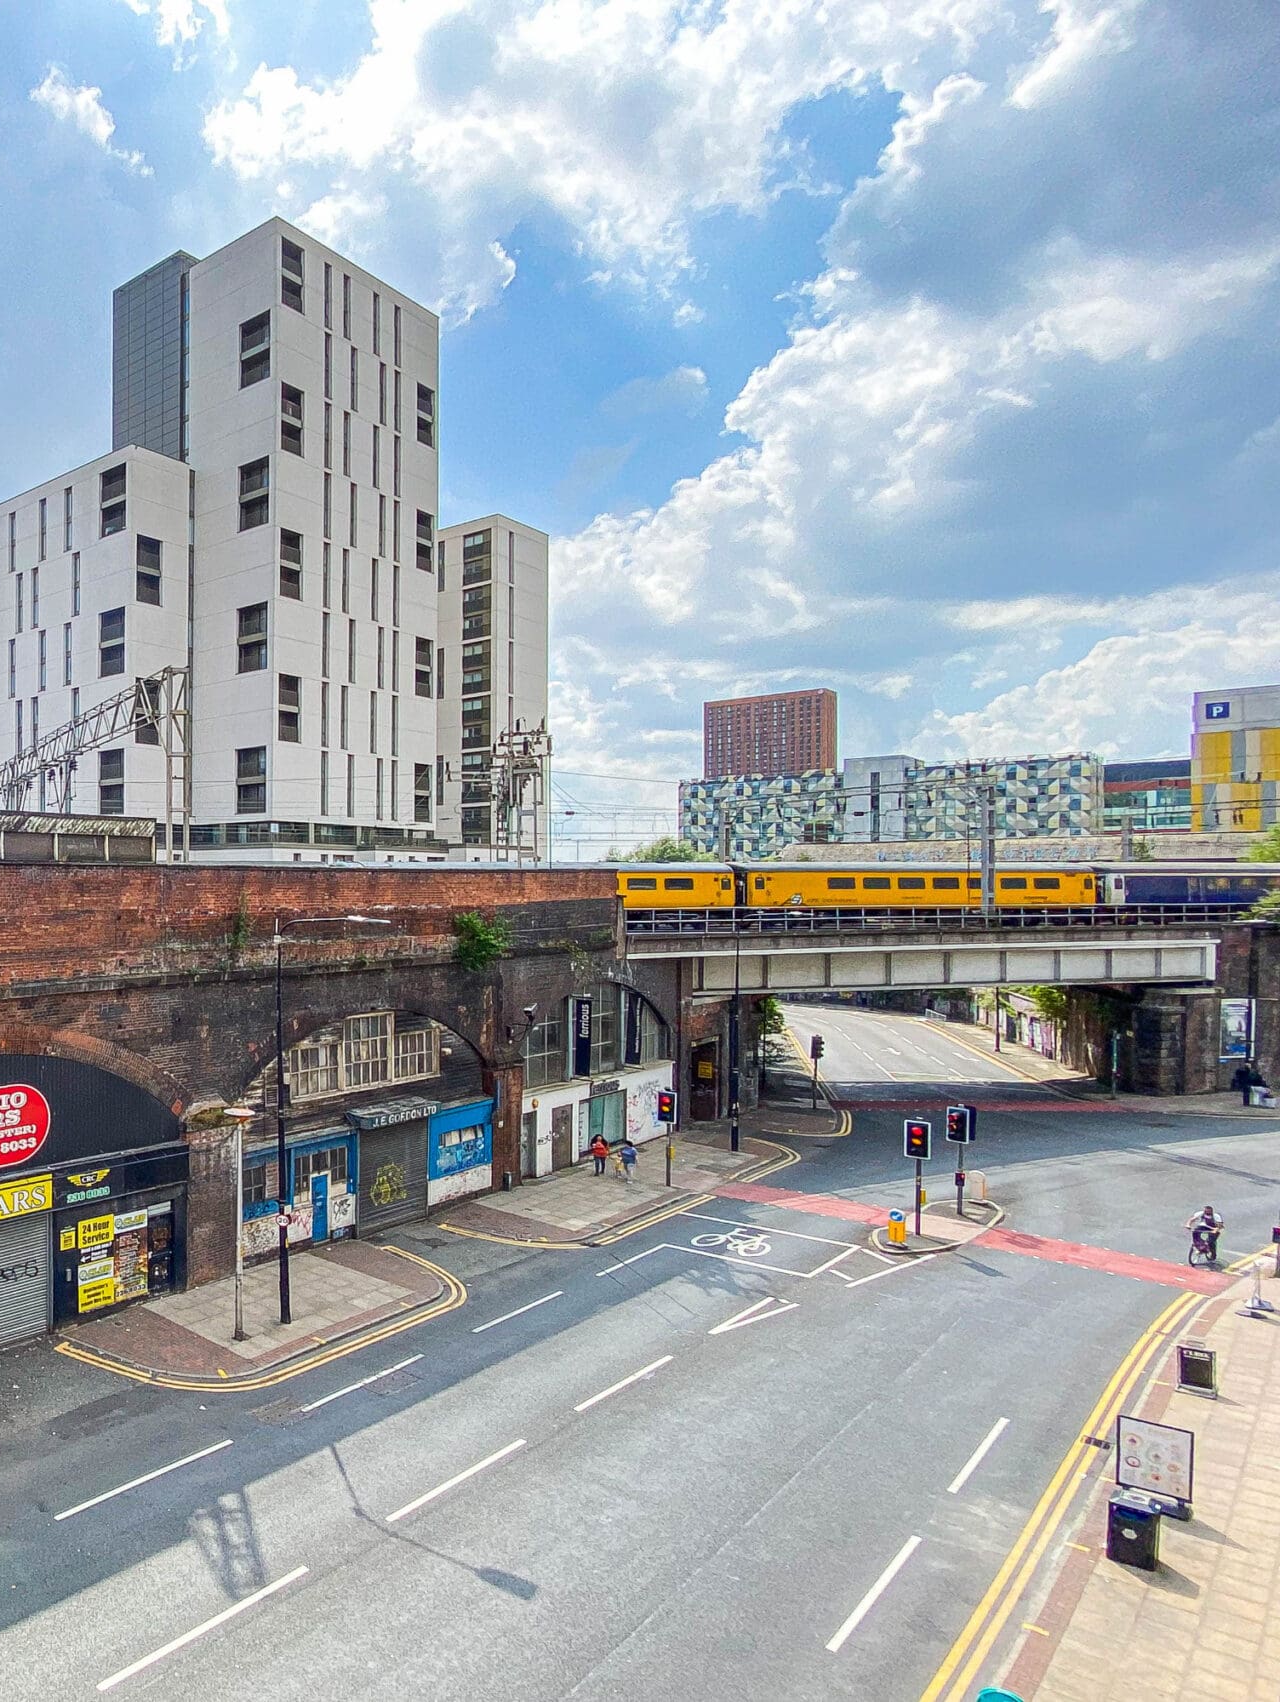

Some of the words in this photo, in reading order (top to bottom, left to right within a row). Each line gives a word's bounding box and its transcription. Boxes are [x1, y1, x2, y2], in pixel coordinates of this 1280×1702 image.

[1212, 706, 1223, 717] P
[423, 1105, 437, 1117] LTD
[0, 1137, 37, 1153] 8033
[81, 1174, 97, 1183] CRC
[82, 1223, 91, 1234] 24
[92, 1221, 110, 1231] Hour
[82, 1232, 110, 1245] Service
